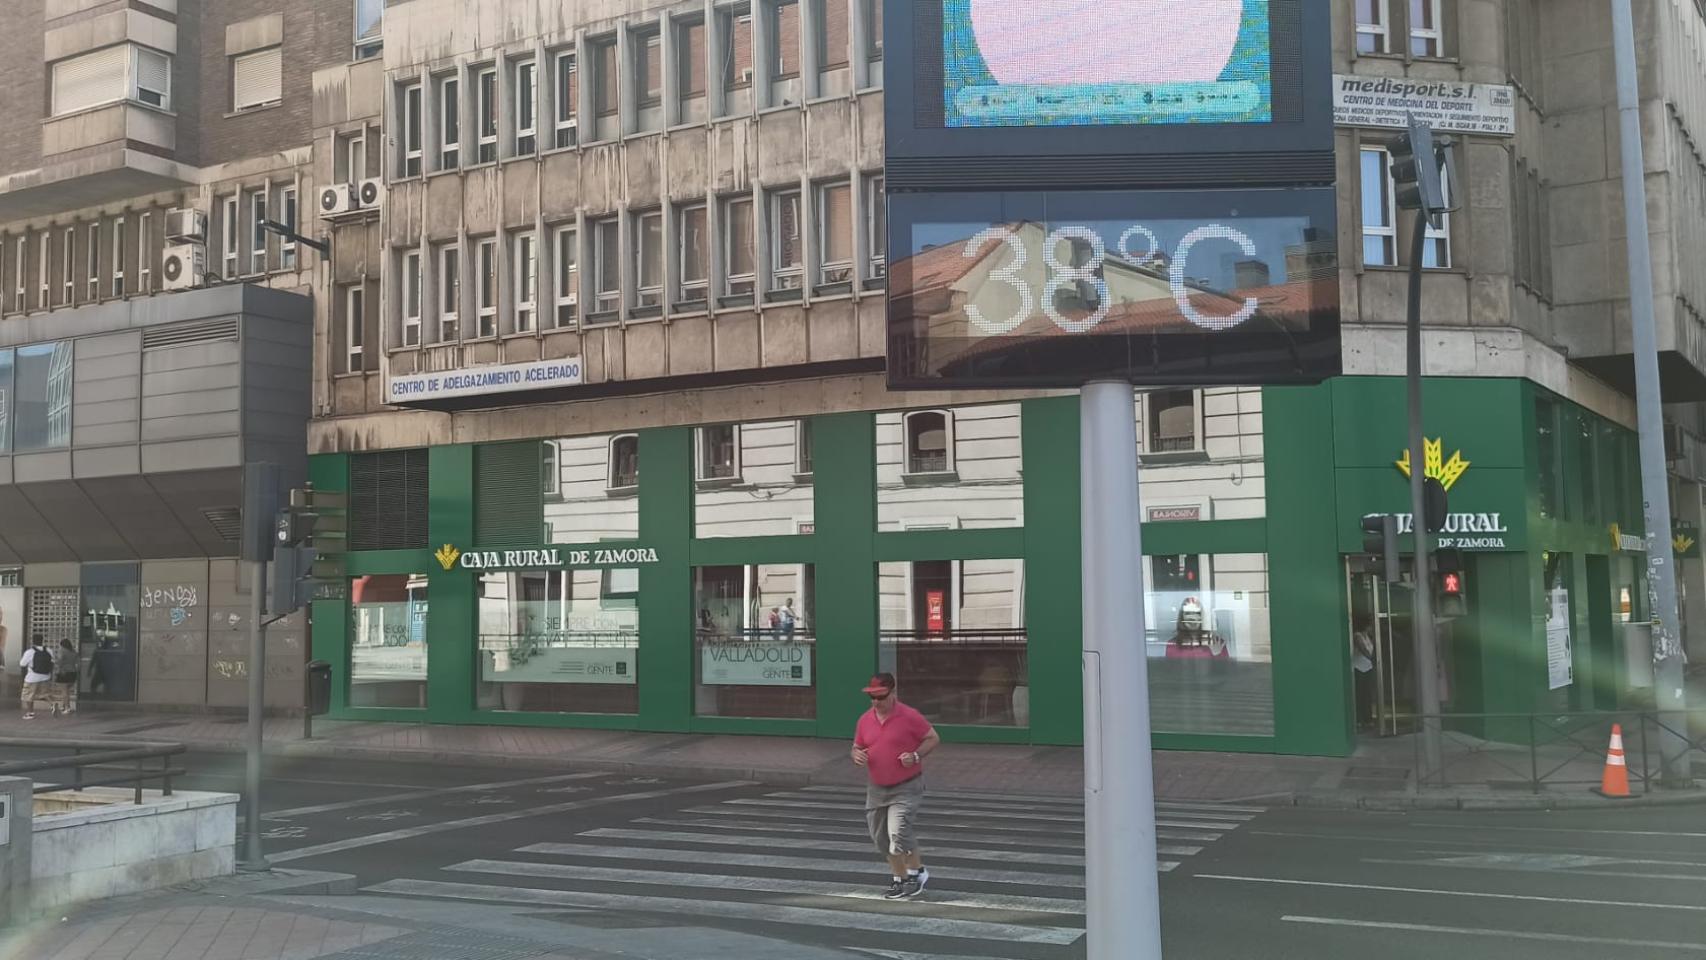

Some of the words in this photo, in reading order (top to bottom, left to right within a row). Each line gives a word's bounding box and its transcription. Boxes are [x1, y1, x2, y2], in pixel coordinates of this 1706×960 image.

[1343, 95, 1374, 105] CENTRO
[1375, 97, 1385, 105] DE
[1388, 98, 1423, 108] MEDICINA
[1425, 100, 1439, 110] DEL
[1441, 102, 1473, 111] DEPORTE
[392, 380, 425, 395] CENTRO
[428, 379, 439, 391] DE
[443, 370, 521, 390] ADELGAZAMIENTO
[525, 364, 579, 382] ACELERADO
[1438, 513, 1507, 533] URAL
[1438, 537, 1454, 548] DE
[1457, 538, 1505, 548] ZAMORA
[460, 551, 504, 569] CAJA
[504, 549, 562, 567] RURAL
[570, 551, 590, 564] DE
[594, 548, 659, 564] ZAMORA
[710, 647, 803, 663] VALLADOLID
[762, 669, 791, 679] GENTE
